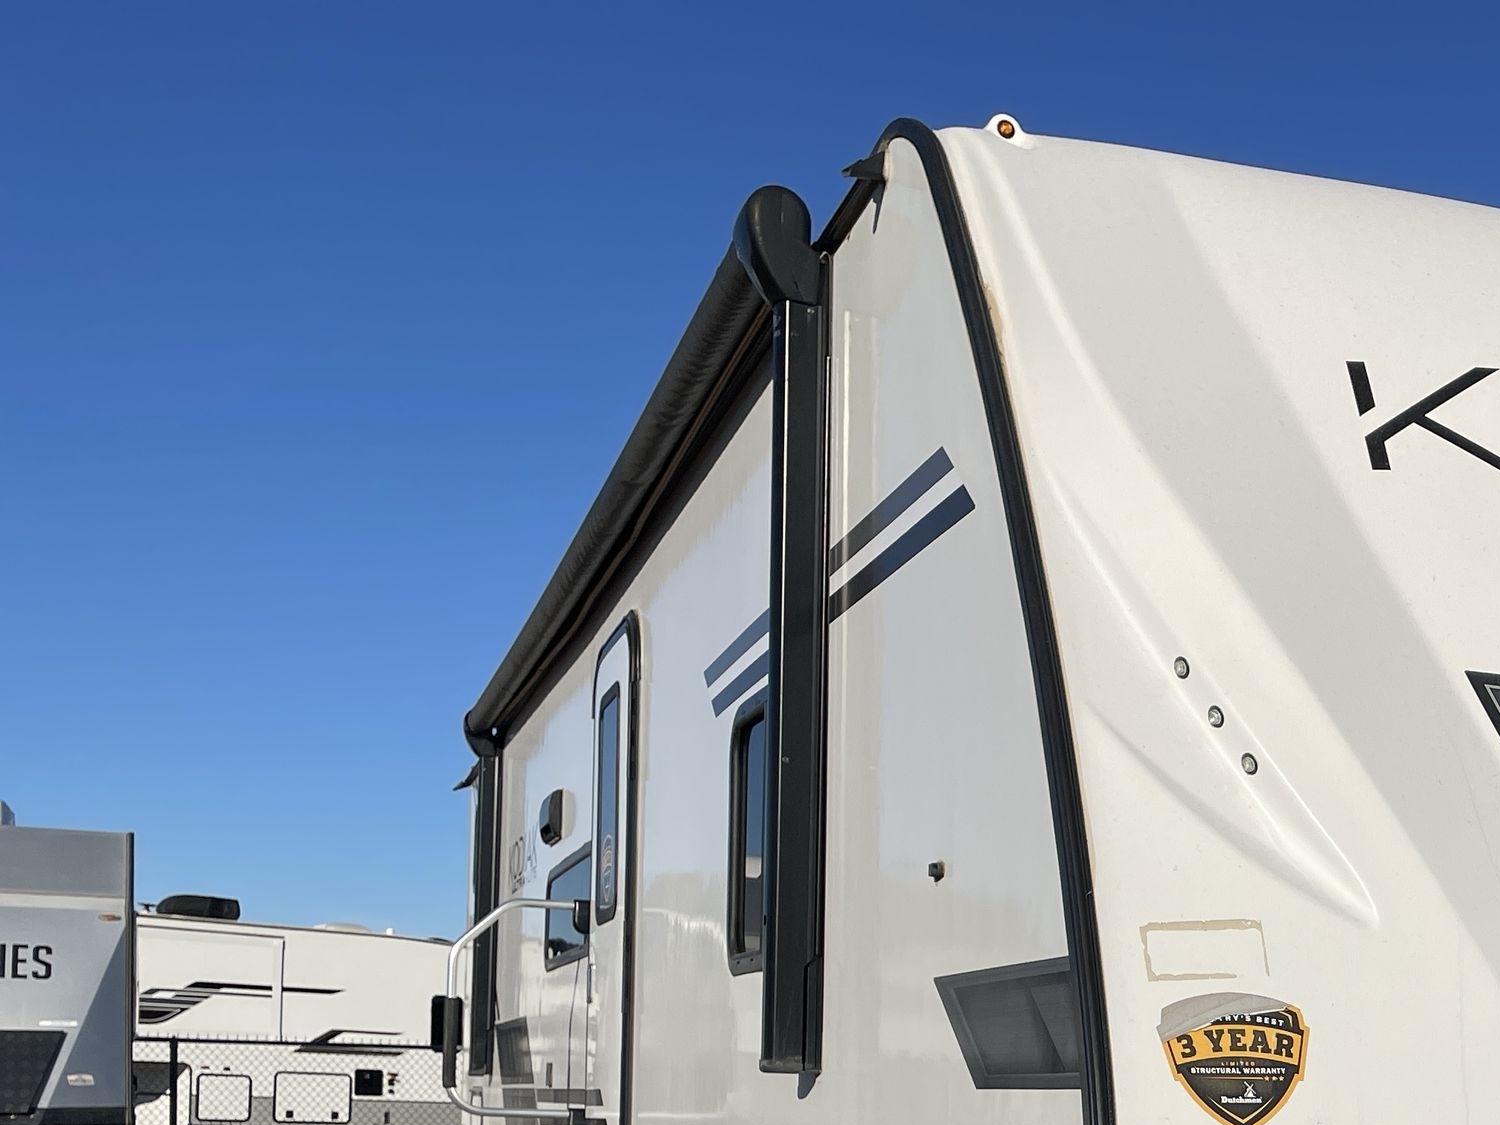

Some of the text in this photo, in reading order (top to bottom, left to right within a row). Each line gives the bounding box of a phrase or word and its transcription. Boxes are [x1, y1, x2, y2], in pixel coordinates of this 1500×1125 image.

[1255, 1015, 1285, 1027] BEST
[1176, 1028, 1295, 1059] 3 YEAR
[1190, 1066, 1286, 1075] STRUCTURAL WARRANTY
